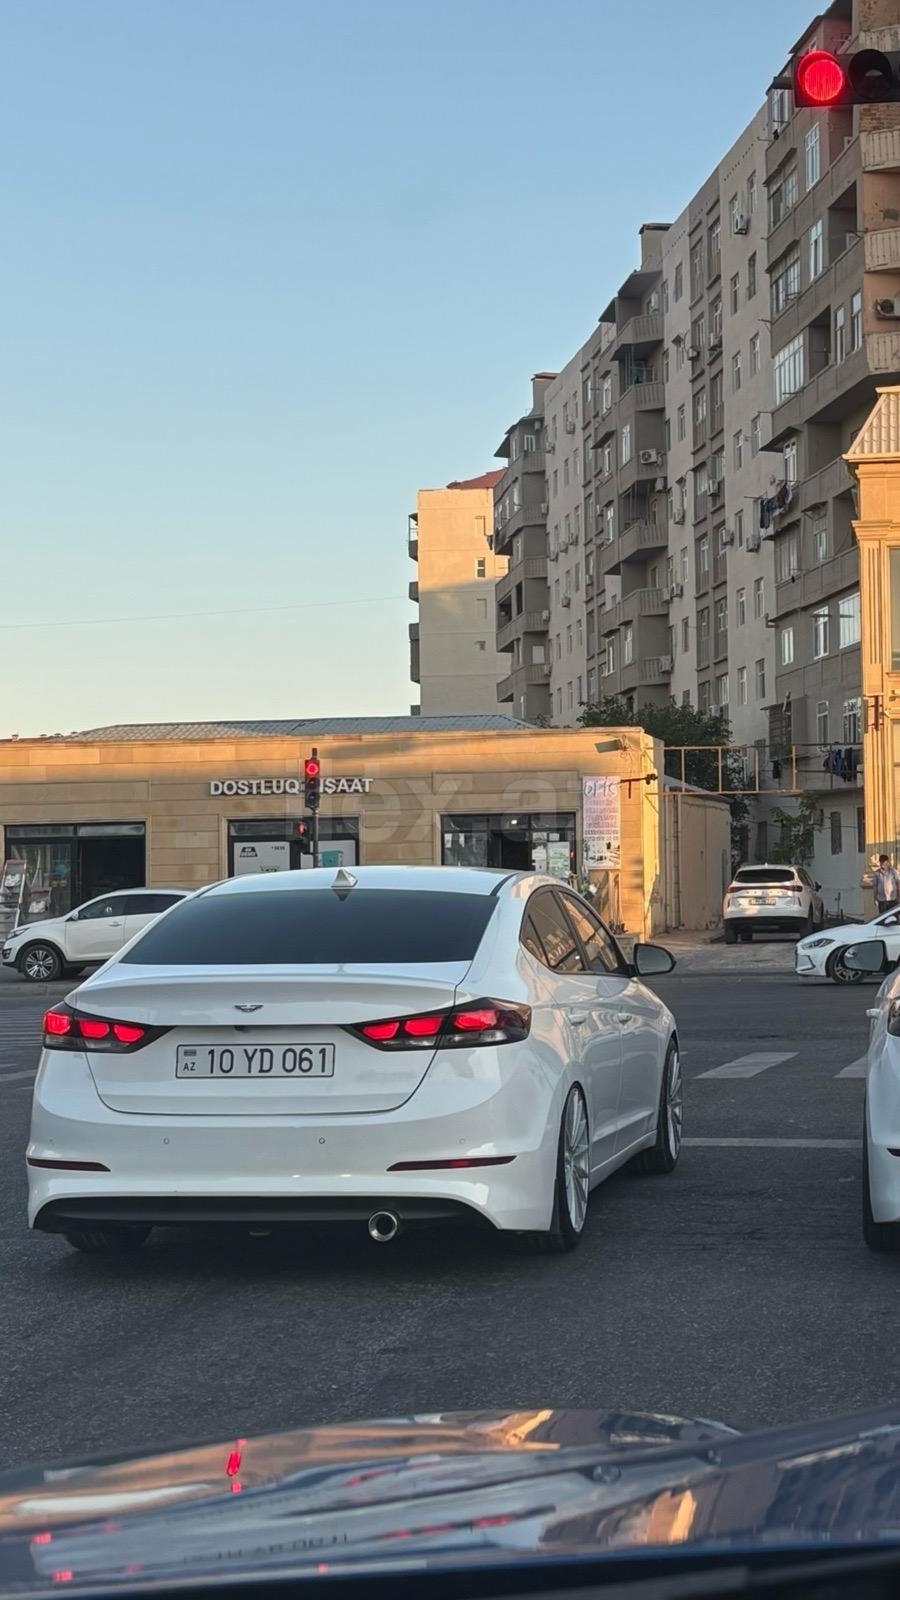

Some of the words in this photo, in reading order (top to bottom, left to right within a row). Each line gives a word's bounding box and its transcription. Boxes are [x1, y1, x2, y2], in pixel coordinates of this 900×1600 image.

[209, 778, 300, 795] DOSTLUQ
[182, 1061, 196, 1072] AZ
[207, 1048, 235, 1074] 10
[243, 1048, 274, 1074] YD
[282, 1047, 327, 1073] 061
